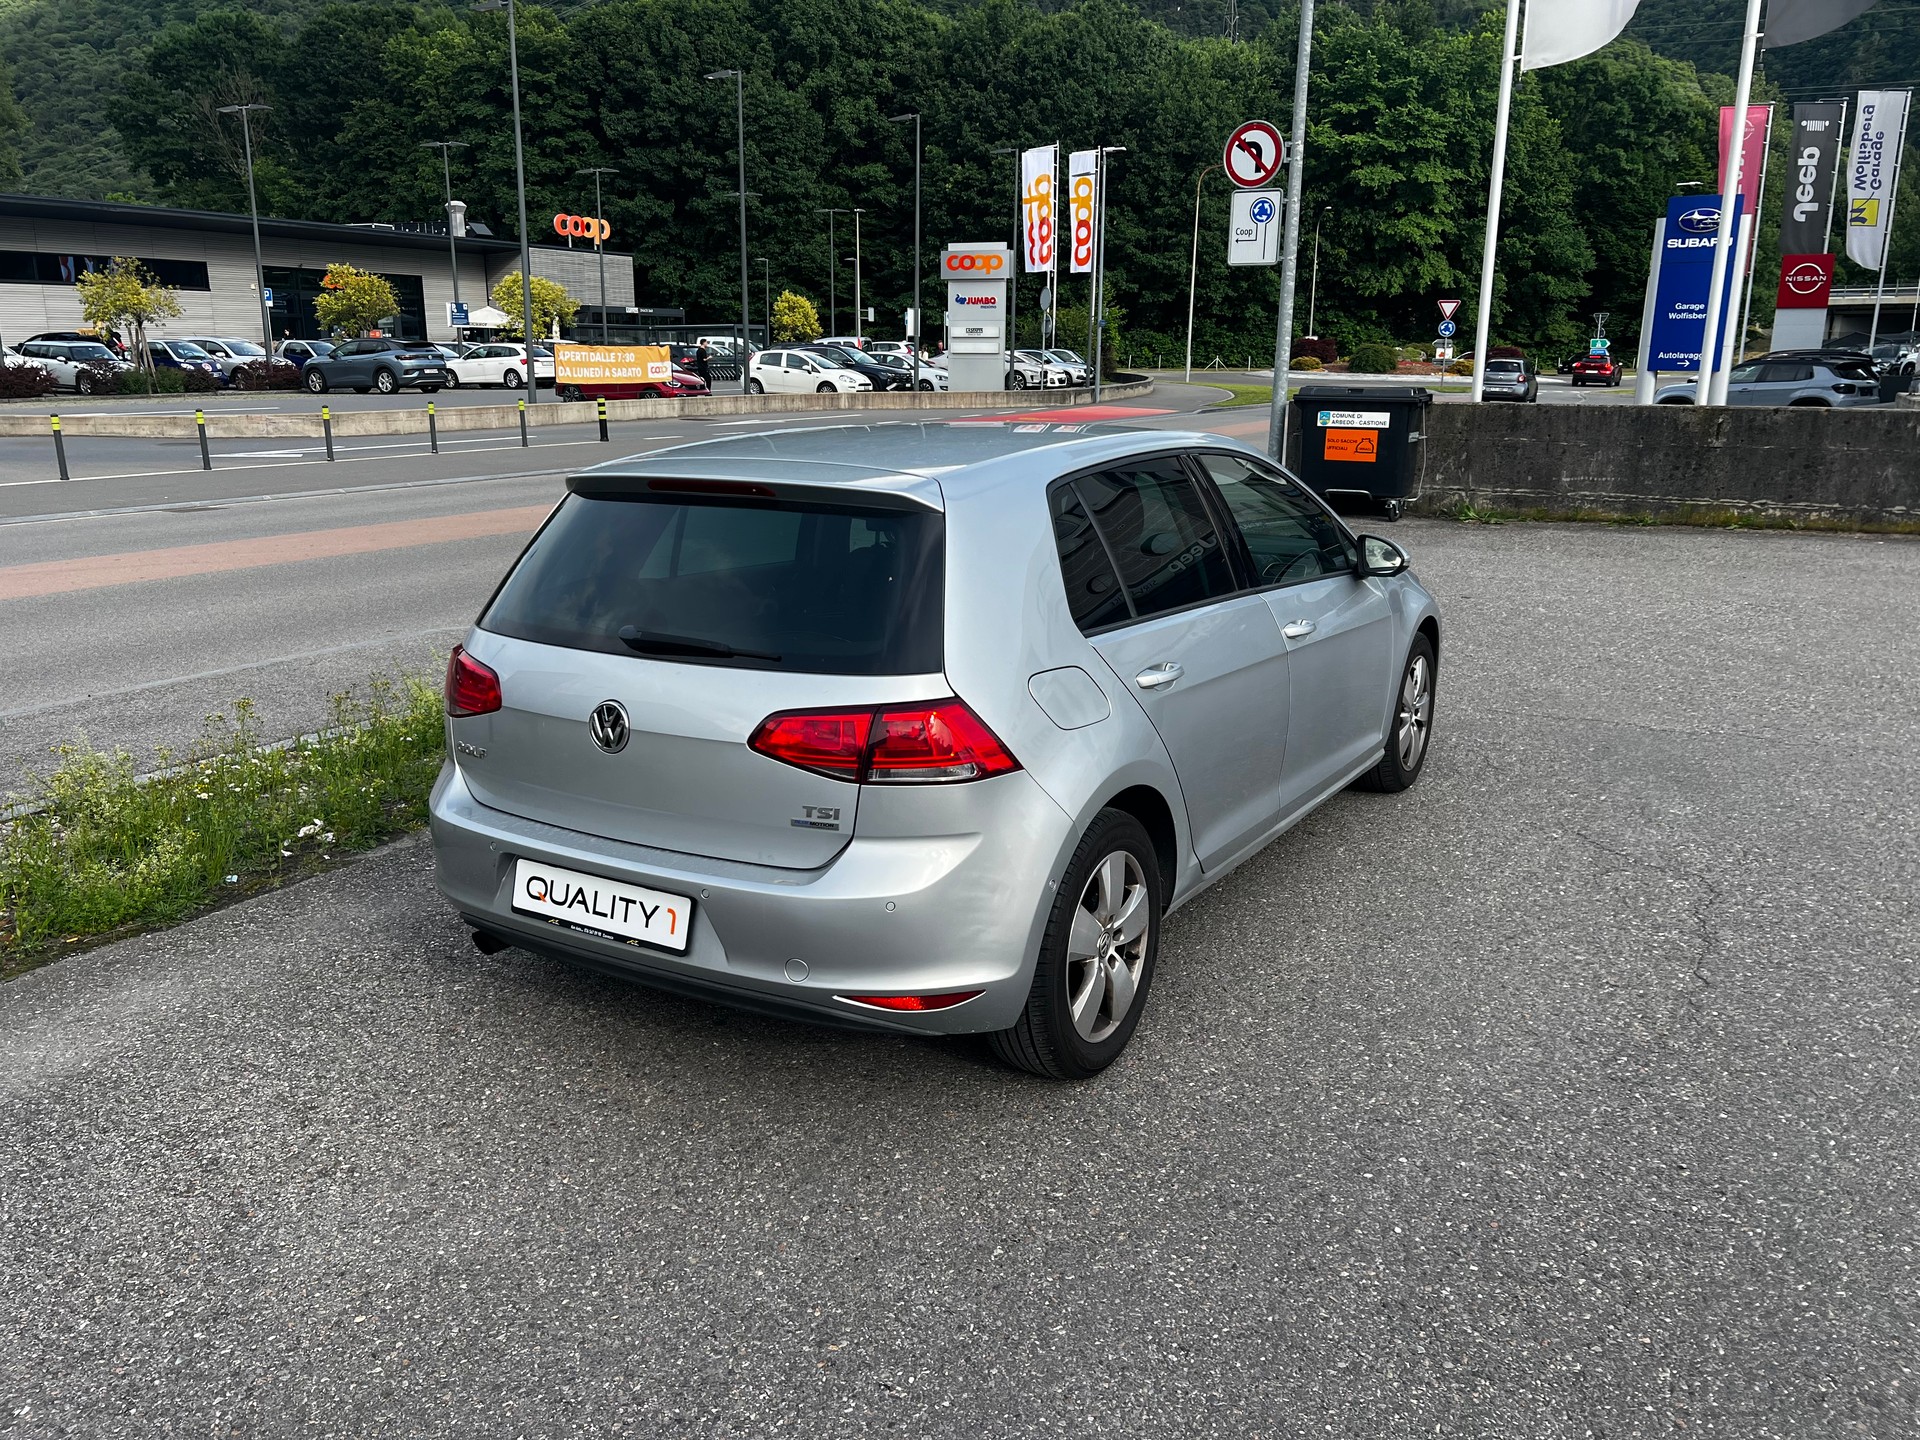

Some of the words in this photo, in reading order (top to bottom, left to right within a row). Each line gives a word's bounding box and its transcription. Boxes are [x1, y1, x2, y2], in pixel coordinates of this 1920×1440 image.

[554, 213, 611, 245] coop
[1235, 227, 1253, 237] Coop
[946, 254, 1004, 275] coop
[1785, 275, 1827, 283] NISSAN
[966, 296, 997, 305] JUMBO
[1675, 302, 1705, 311] Garage
[558, 350, 589, 362] APERTI
[590, 351, 616, 362] DALLE
[617, 352, 635, 362] 7:30
[558, 366, 572, 377] DA
[573, 365, 603, 377] LUNEDÌ
[604, 367, 611, 377] A
[612, 367, 642, 377] SABATO
[456, 740, 487, 759] GOLF
[802, 805, 841, 820] TSI
